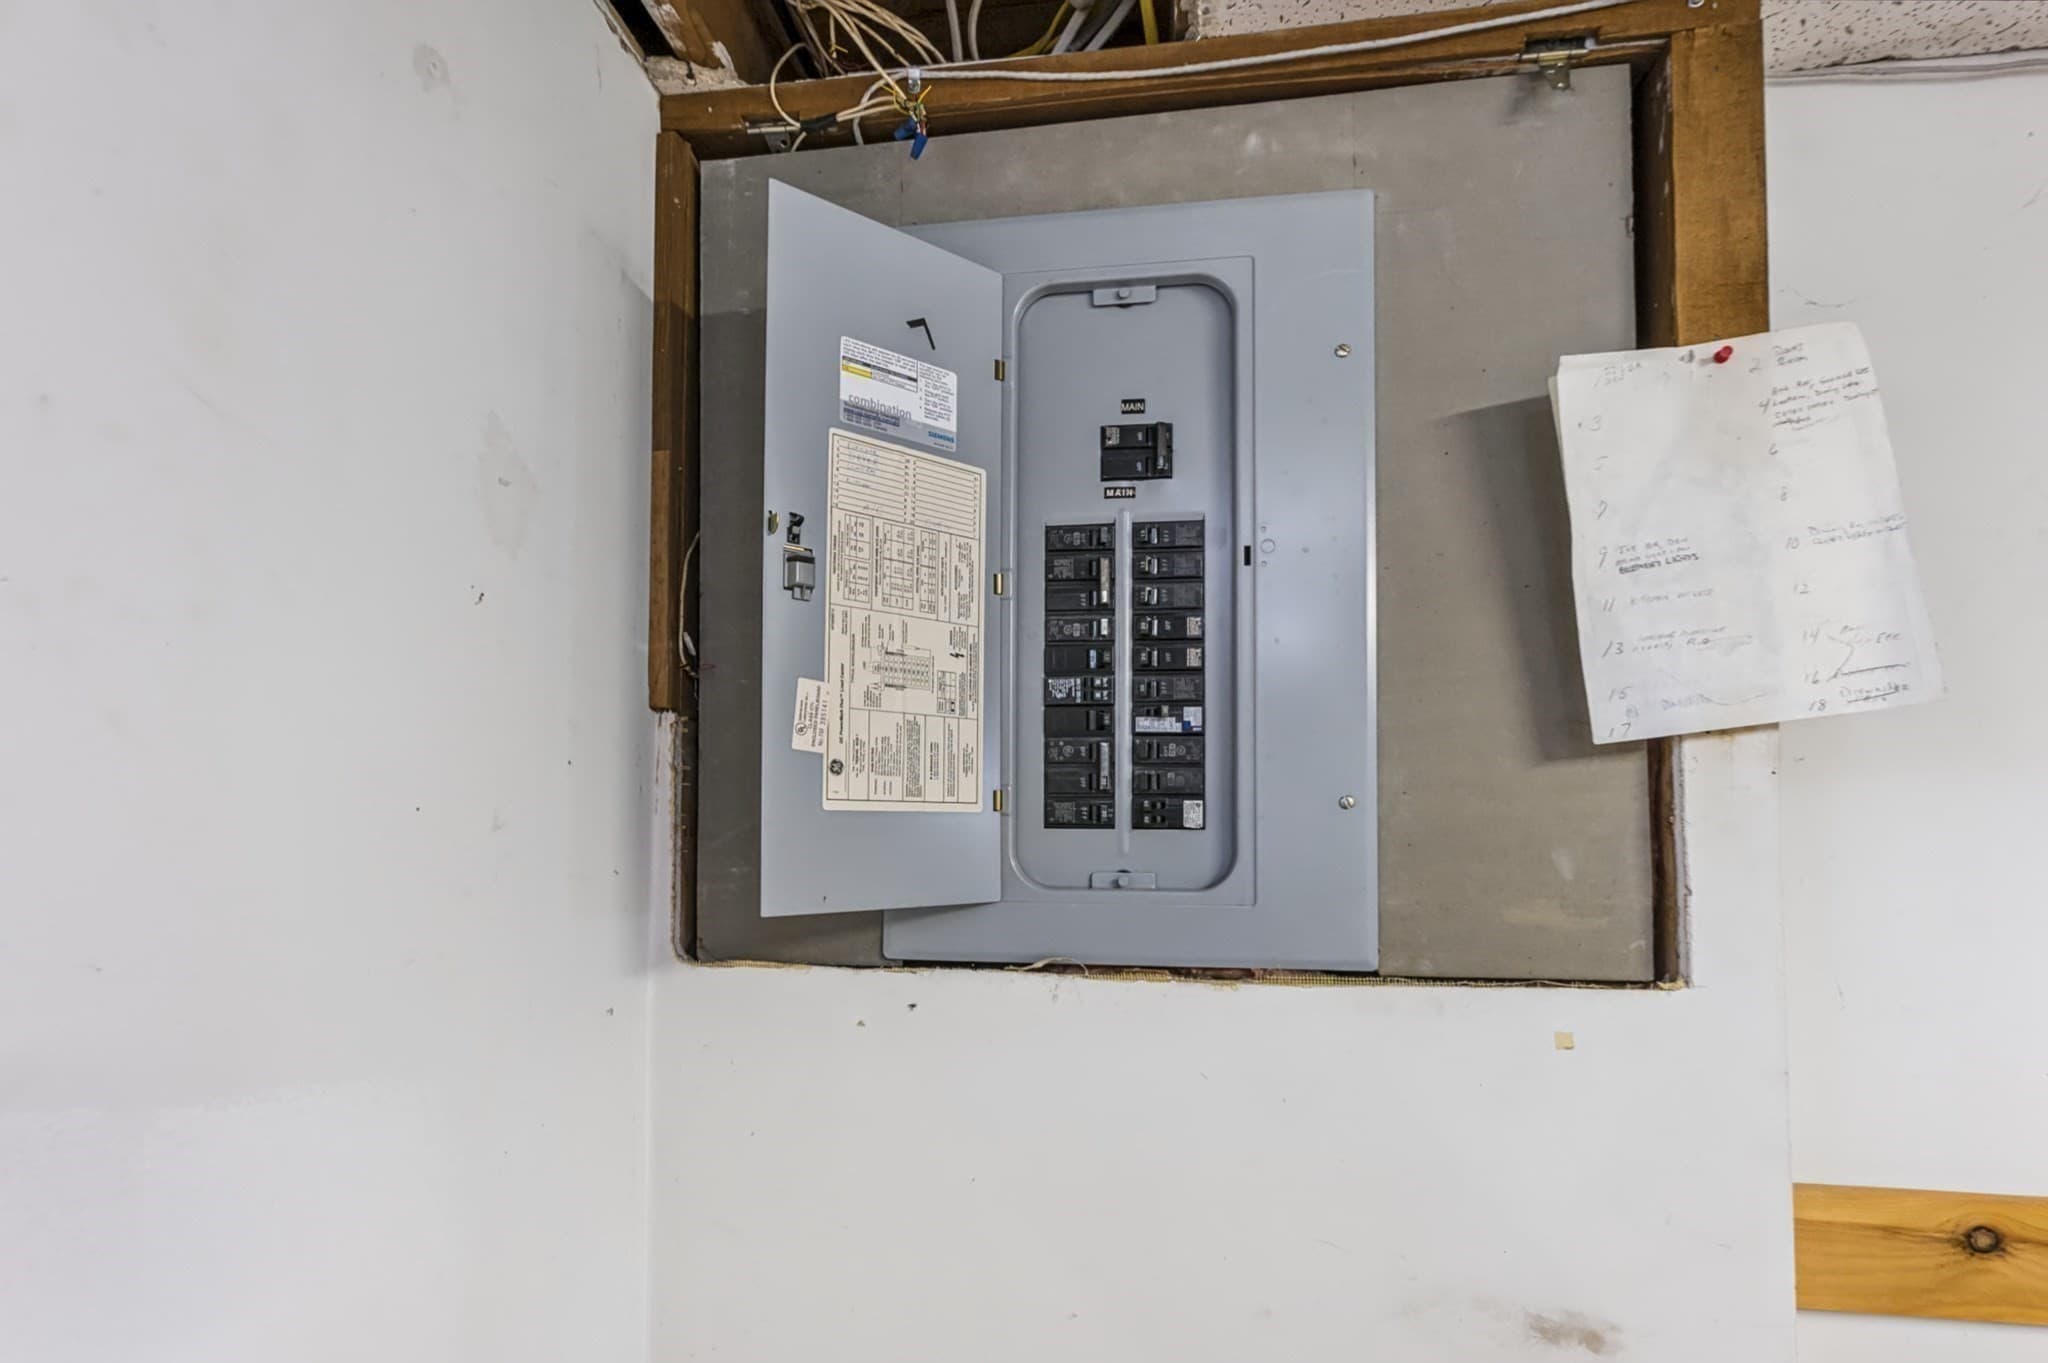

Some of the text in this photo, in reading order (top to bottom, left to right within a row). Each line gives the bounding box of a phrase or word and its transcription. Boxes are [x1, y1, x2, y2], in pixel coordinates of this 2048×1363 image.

[848, 393, 912, 421] combination
[1121, 401, 1145, 412] MAIN
[1757, 398, 1771, 415] 4
[1588, 414, 1603, 432] 3
[928, 430, 955, 443] SIEMENS
[1768, 442, 1779, 456] 6
[1106, 489, 1134, 497] MAIN
[1785, 536, 1800, 550] 10
[1598, 545, 1609, 569] 9
[1793, 583, 1811, 595] 12
[1601, 595, 1616, 613] 11
[1801, 625, 1821, 645] 14
[1600, 641, 1624, 659] 13
[1802, 669, 1820, 685] 16
[1608, 685, 1633, 702] 15
[1808, 698, 1827, 712] 18
[1607, 722, 1632, 738] 17
